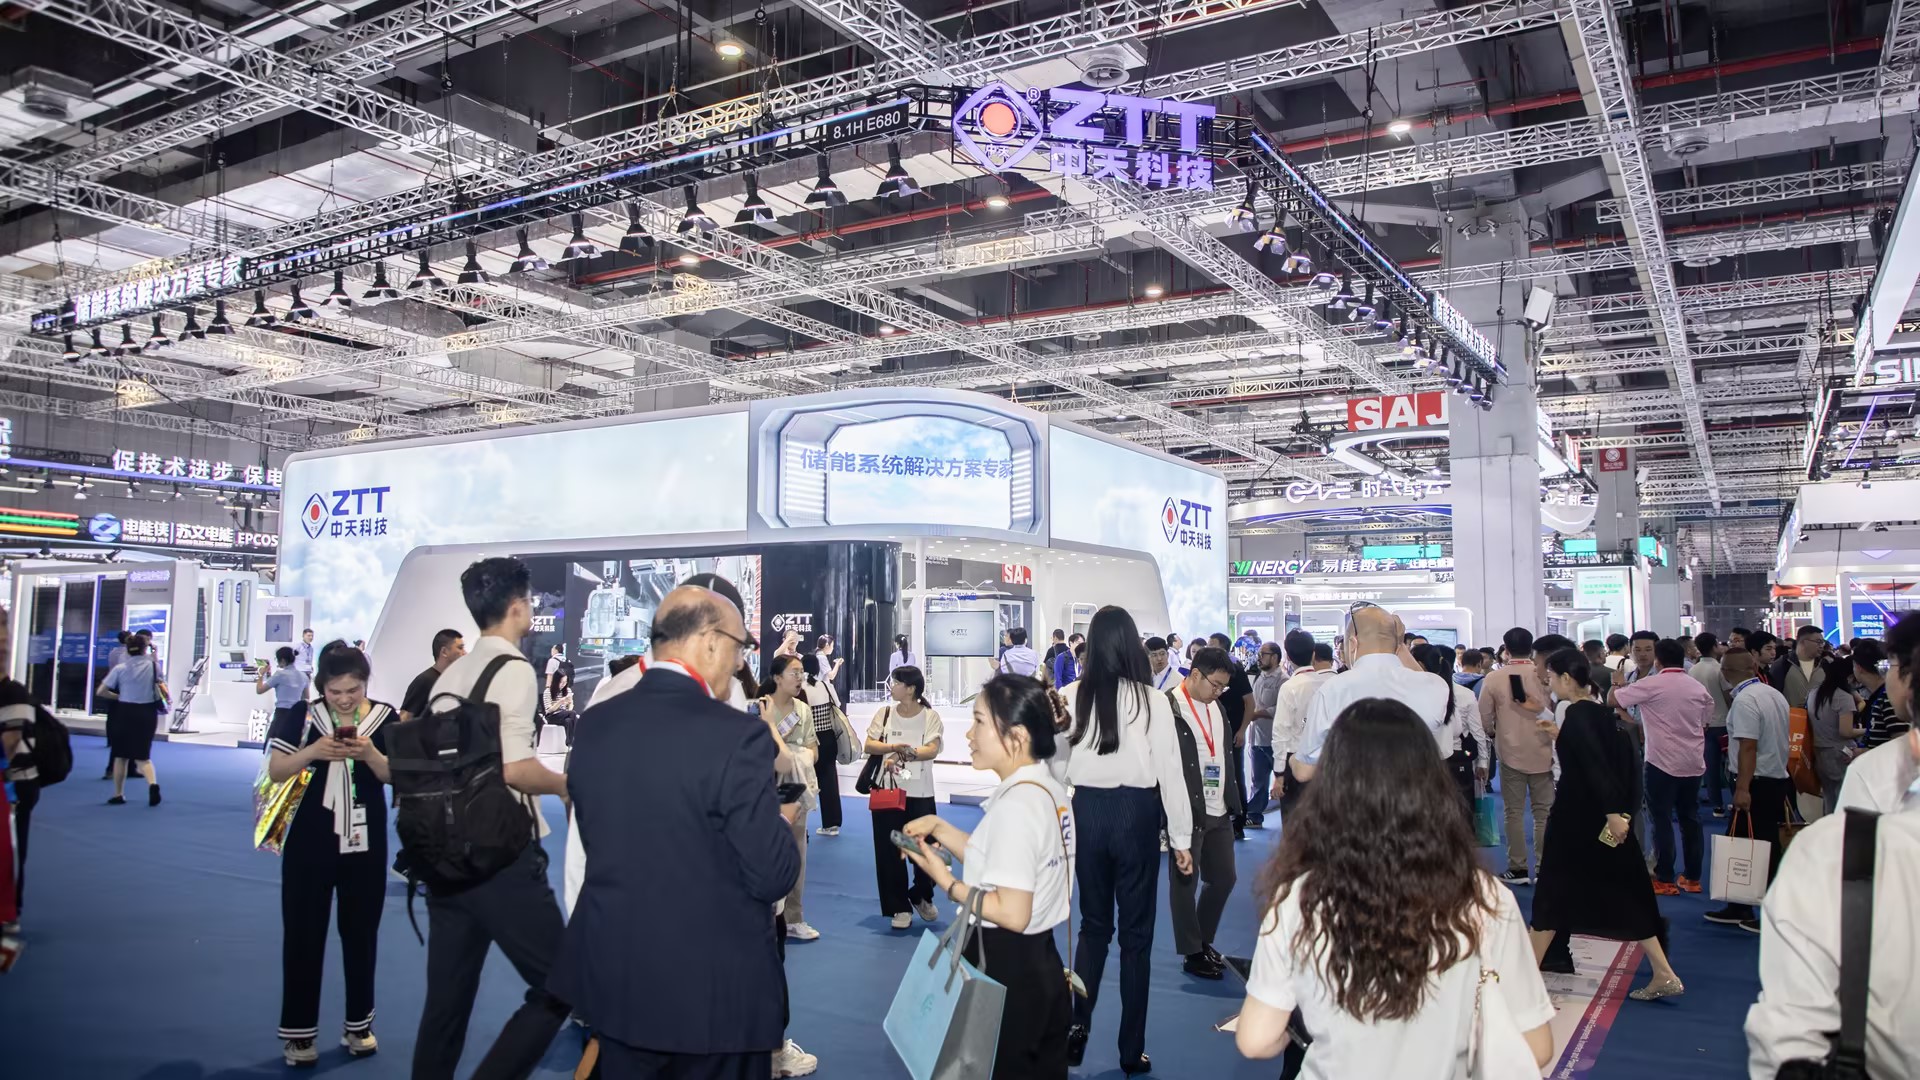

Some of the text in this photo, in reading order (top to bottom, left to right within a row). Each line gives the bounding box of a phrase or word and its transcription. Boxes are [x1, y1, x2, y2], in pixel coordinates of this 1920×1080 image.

[833, 110, 901, 139] 8.1H E680
[1050, 88, 1216, 151] ZTT
[985, 144, 1010, 158] 中天
[1050, 144, 1214, 192] 中天科技
[75, 255, 243, 324] 储能系统解决方案专家
[1354, 391, 1449, 431] SAJ
[112, 449, 234, 481] 促技术进步
[800, 448, 1014, 479] 储能系统解决方案专家
[331, 485, 391, 516] ZTT
[1180, 499, 1212, 530] ZTT
[122, 518, 170, 537] 电能侠
[175, 523, 234, 543] 苏文电能
[330, 517, 388, 538] 中天科技
[1180, 529, 1212, 550] 中天科技
[1003, 563, 1032, 585] SAJ
[1321, 557, 1398, 573] 易能数字
[533, 615, 556, 625] ZTT
[785, 613, 813, 624] ZTT
